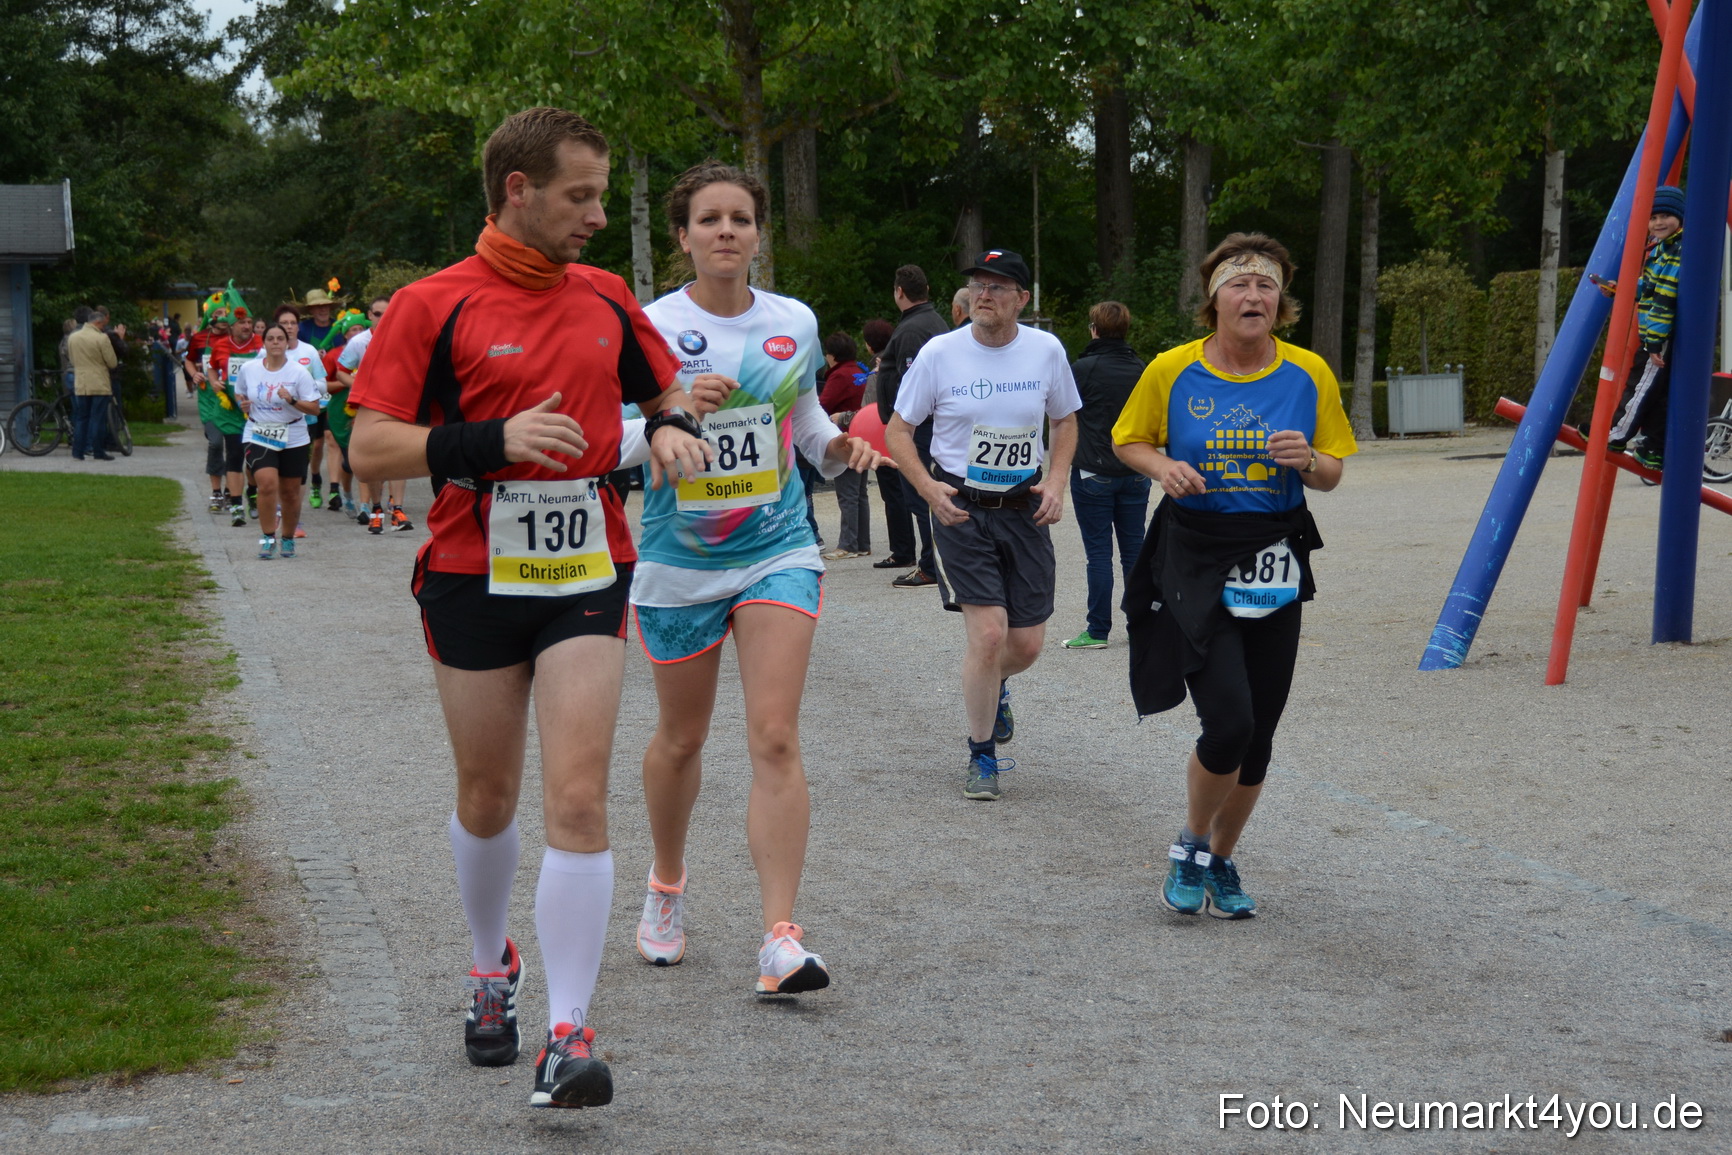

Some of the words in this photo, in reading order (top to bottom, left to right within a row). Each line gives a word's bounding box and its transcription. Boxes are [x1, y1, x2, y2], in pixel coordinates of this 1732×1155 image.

[680, 359, 712, 368] PARTL
[951, 386, 968, 396] FeG
[996, 380, 1041, 393] NEUMARKT
[708, 417, 757, 432] Neumarkt
[973, 428, 998, 440] PARTL
[998, 432, 1028, 441] Neumarkt
[975, 440, 1032, 468] 2789
[981, 471, 1023, 484] Christian
[706, 480, 753, 499] Sophie
[496, 492, 535, 504] PARTL
[518, 508, 589, 553] 130
[520, 562, 587, 581] Christian
[1233, 592, 1277, 606] Claudia
